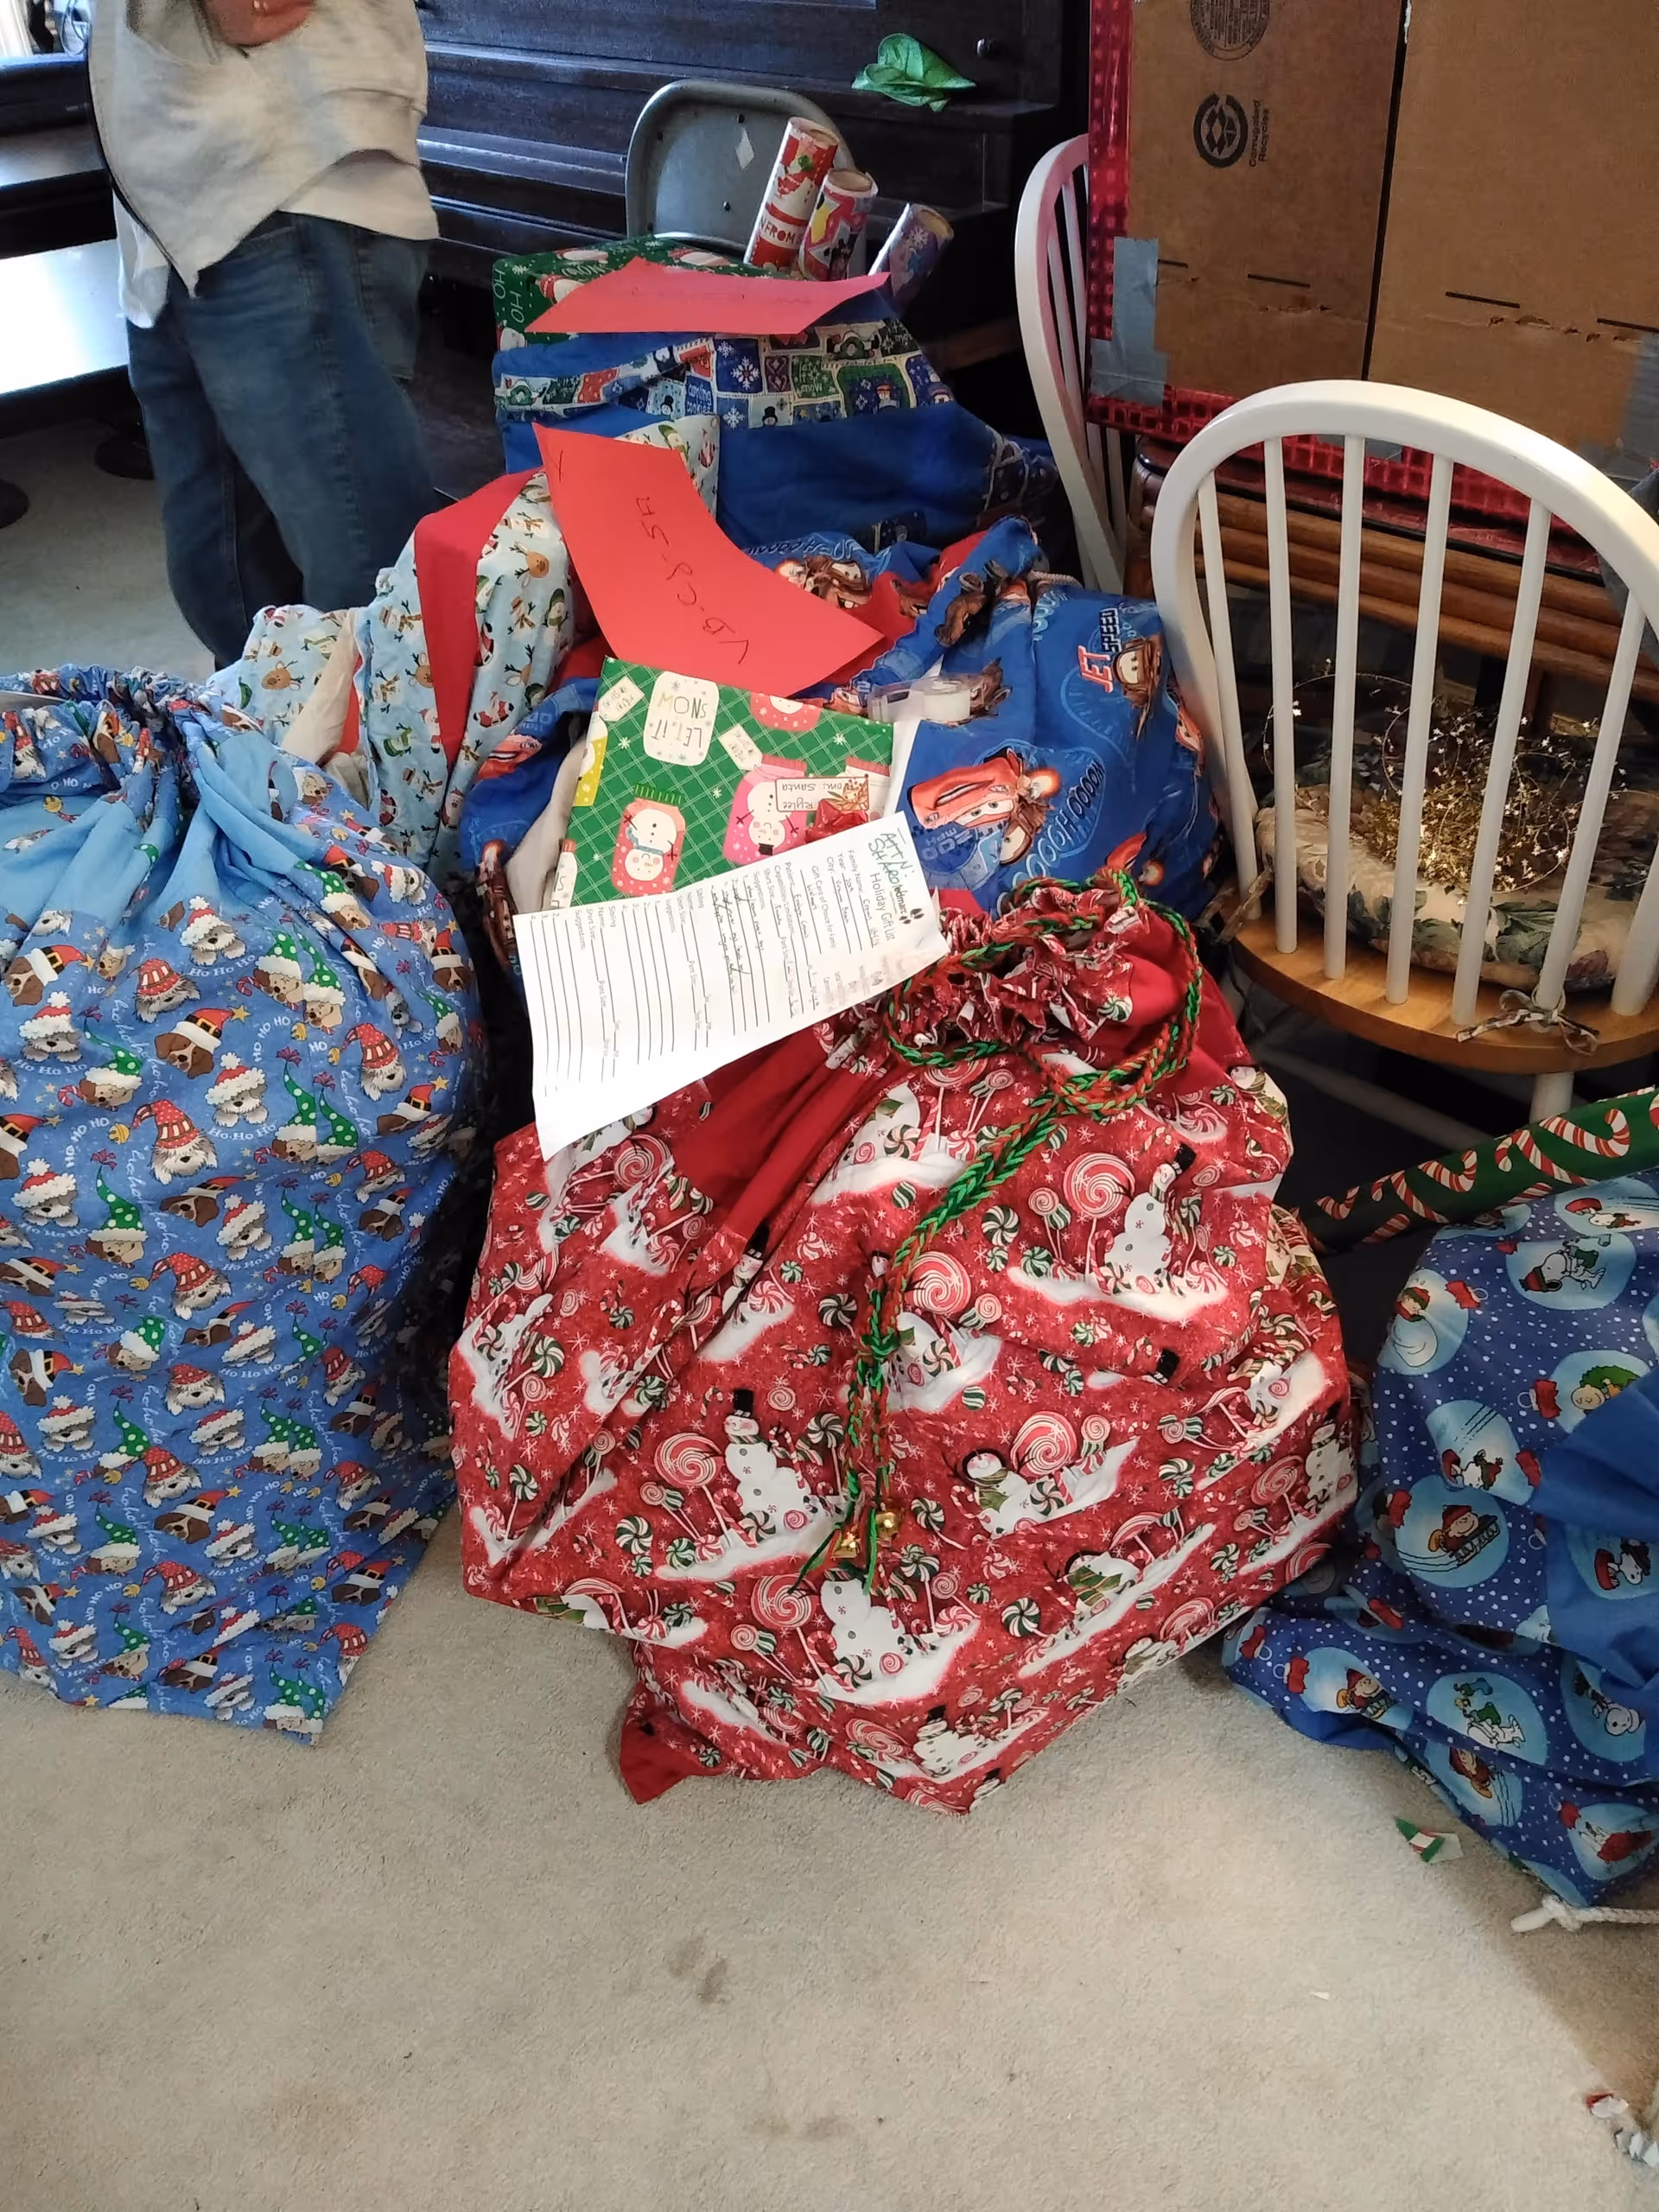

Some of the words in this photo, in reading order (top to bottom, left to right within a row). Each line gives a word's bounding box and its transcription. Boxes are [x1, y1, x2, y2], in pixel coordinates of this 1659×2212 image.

[765, 220, 796, 245] FROM
[493, 269, 506, 299] HO
[509, 290, 525, 323] HO
[1099, 607, 1122, 653] SPEED
[1077, 645, 1114, 693] JET
[656, 691, 708, 718] SNOW
[781, 783, 817, 791] Santa
[782, 797, 814, 810] Rylee
[846, 849, 861, 873] Family
[810, 865, 821, 880] Gift
[814, 880, 826, 896] Card
[868, 872, 891, 912] Holiday
[257, 896, 275, 909] HO
[607, 906, 618, 928] Sibling
[820, 903, 833, 925] Choice
[880, 911, 894, 928] Gift
[885, 927, 898, 942] List
[371, 937, 386, 950] HO
[586, 908, 595, 925] Shirt
[597, 980, 607, 995] Pant
[188, 967, 210, 977] Ho
[213, 965, 235, 976] Ho
[688, 960, 696, 974] Pant
[88, 985, 106, 995] HO
[273, 1016, 291, 1027] HO
[257, 1021, 271, 1039] HO
[252, 1042, 263, 1062] HO
[308, 1041, 327, 1052] HO
[14, 1058, 35, 1072] Ho
[37, 1064, 62, 1076] Ho
[64, 1063, 87, 1075] Ho
[208, 1128, 230, 1140] Ho
[257, 1123, 276, 1137] Ho
[66, 1144, 76, 1167] HO
[71, 1124, 87, 1142] HO
[91, 1116, 110, 1128] HO
[67, 1227, 89, 1236] Ho
[93, 1276, 108, 1289] HO
[110, 1272, 129, 1281] HO
[314, 1290, 330, 1303] HO
[59, 1323, 79, 1334] Ho
[82, 1325, 103, 1335] Ho
[105, 1324, 124, 1333] Ho
[218, 1367, 238, 1378] Ho
[240, 1370, 261, 1379] Ho
[264, 1363, 282, 1376] Ho
[284, 1375, 298, 1387] HO
[57, 1453, 79, 1463] Ho
[80, 1449, 101, 1459] Ho
[191, 1457, 213, 1466] Ho
[214, 1455, 233, 1465] Ho
[264, 1480, 281, 1492] HO
[292, 1487, 308, 1497] HO
[249, 1491, 263, 1503] HO
[245, 1504, 254, 1521] HO
[230, 1565, 248, 1573] Ho
[294, 1574, 309, 1584] HO
[90, 1591, 103, 1605] HO
[105, 1582, 122, 1592] HO
